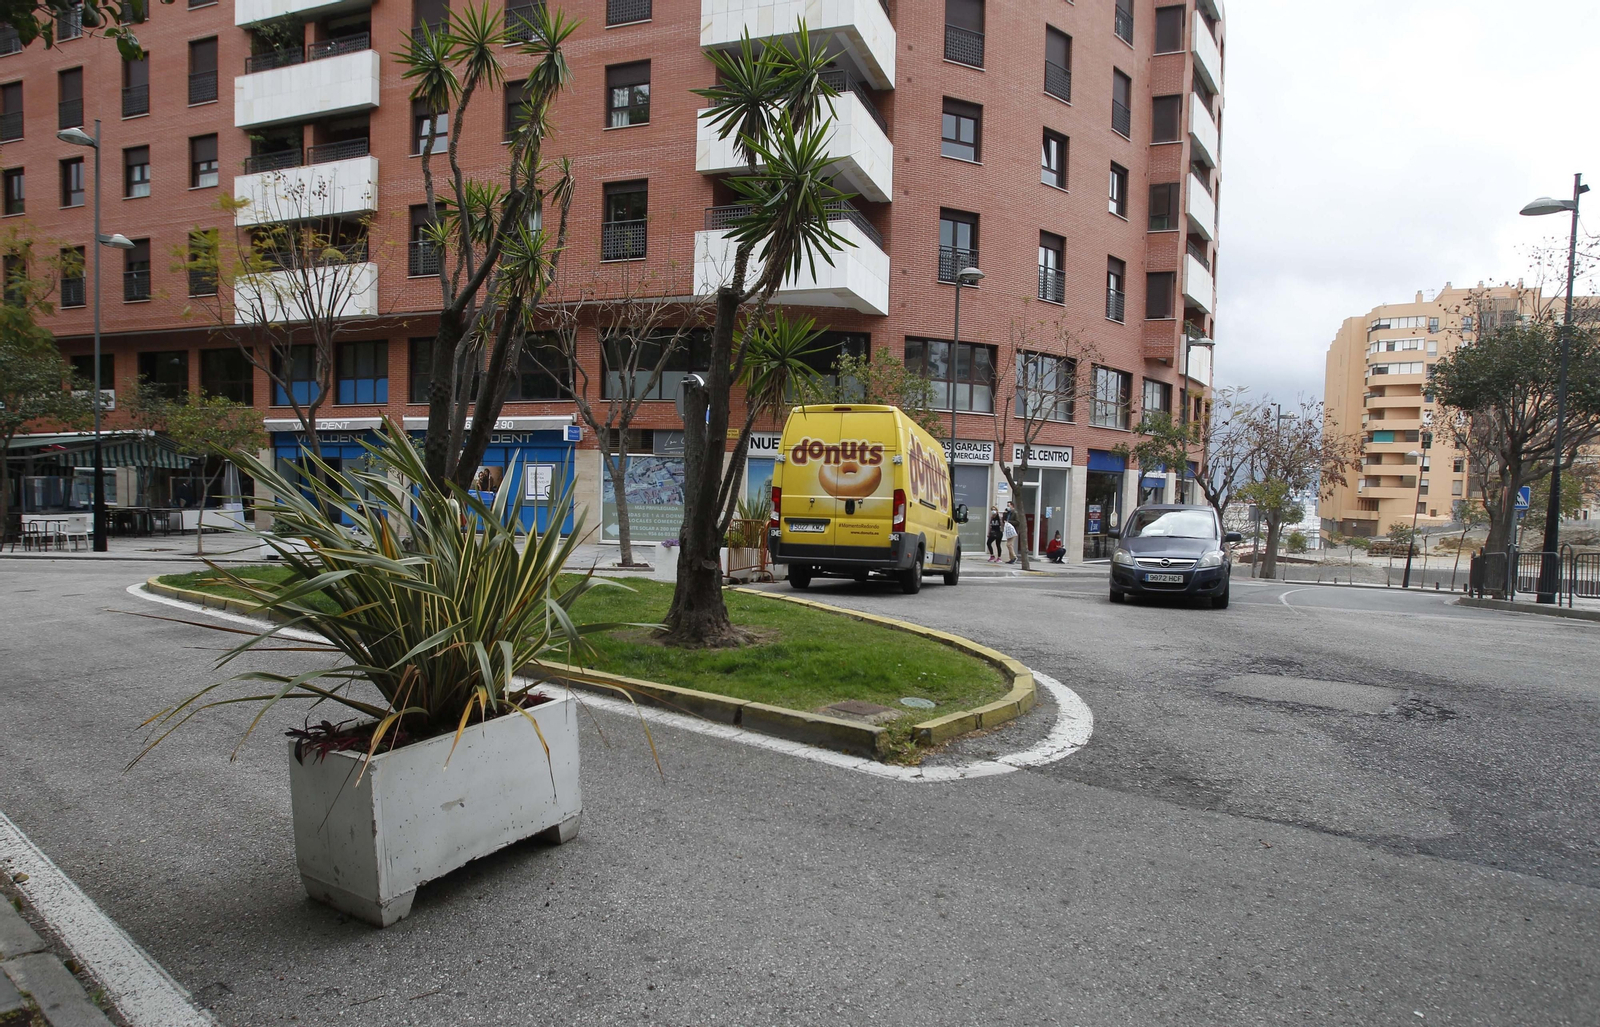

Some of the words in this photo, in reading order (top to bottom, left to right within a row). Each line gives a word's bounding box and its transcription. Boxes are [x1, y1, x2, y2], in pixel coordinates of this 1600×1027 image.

[792, 438, 883, 465] donuts
[955, 442, 992, 453] GARAJES
[1029, 449, 1037, 460] EL
[1038, 449, 1070, 463] CENTRO
[909, 430, 948, 512] donuts
